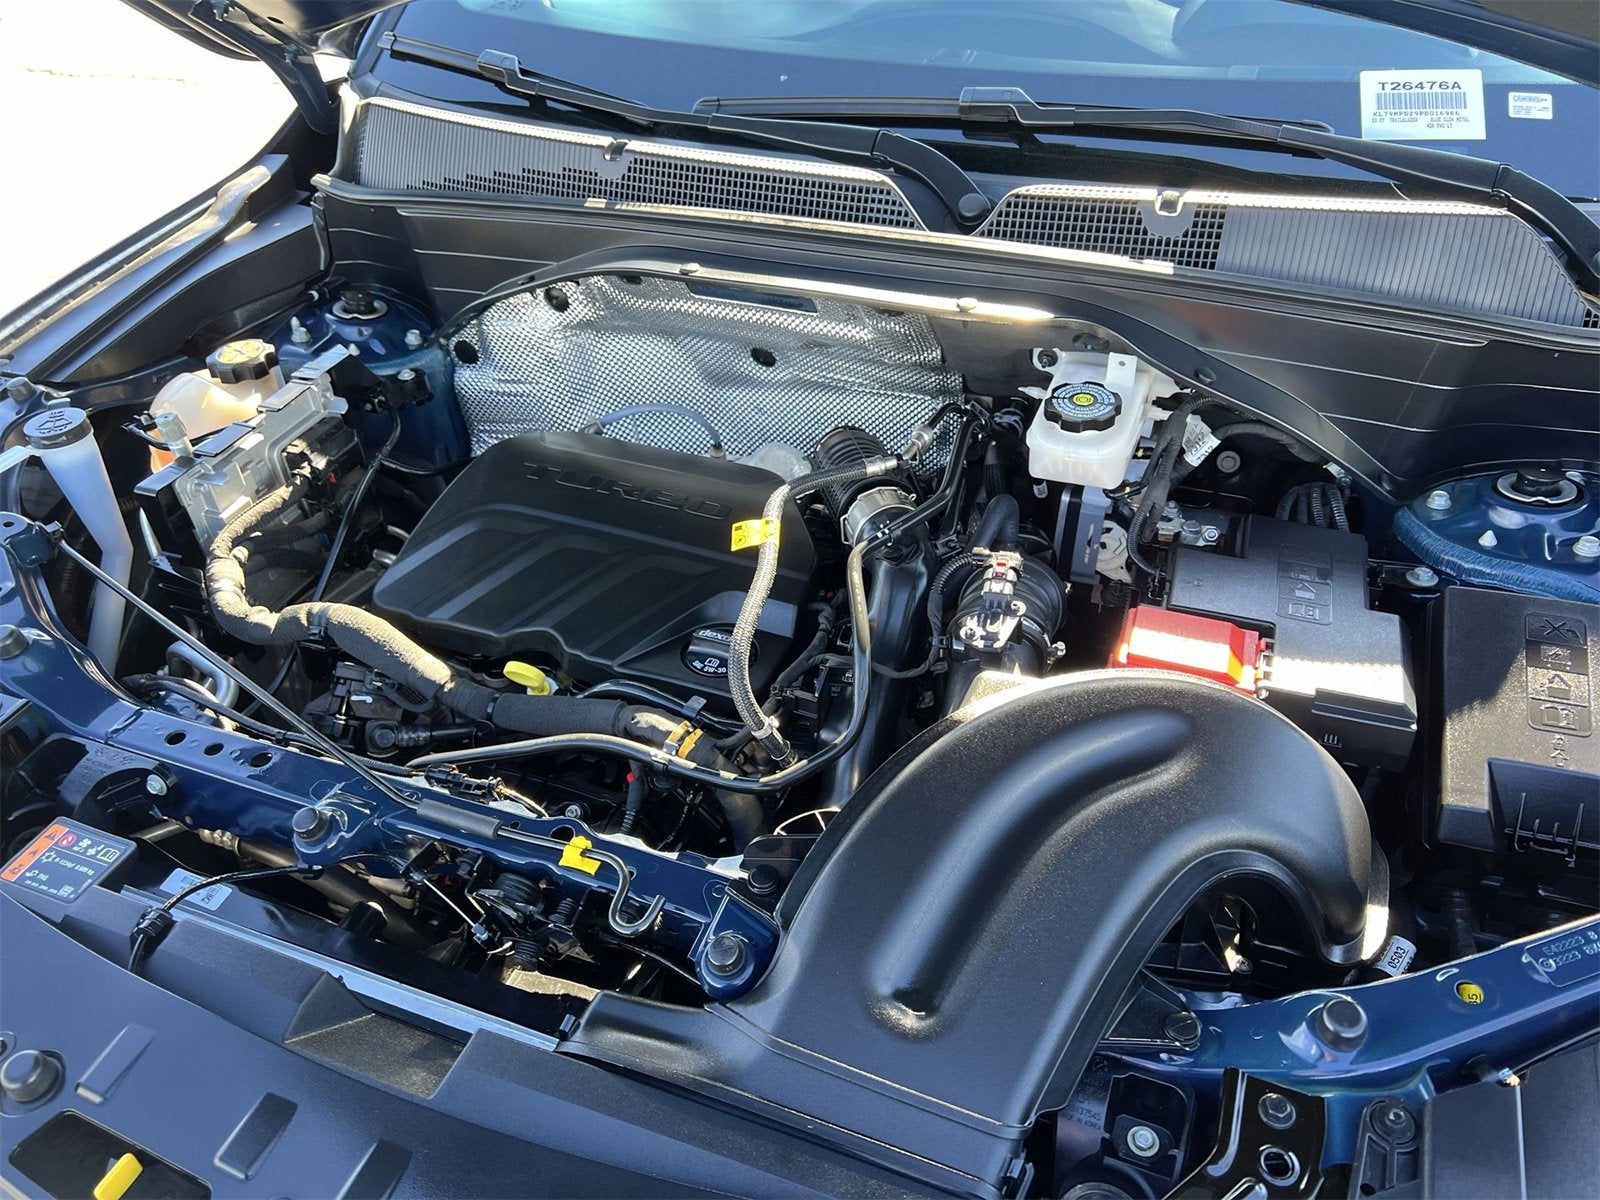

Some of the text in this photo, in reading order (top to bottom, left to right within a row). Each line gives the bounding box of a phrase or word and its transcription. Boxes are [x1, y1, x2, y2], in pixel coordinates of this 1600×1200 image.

[1378, 81, 1462, 91] T26476A
[523, 462, 732, 520] TURBO
[703, 666, 727, 674] 5W-30
[1388, 946, 1406, 969] 0503
